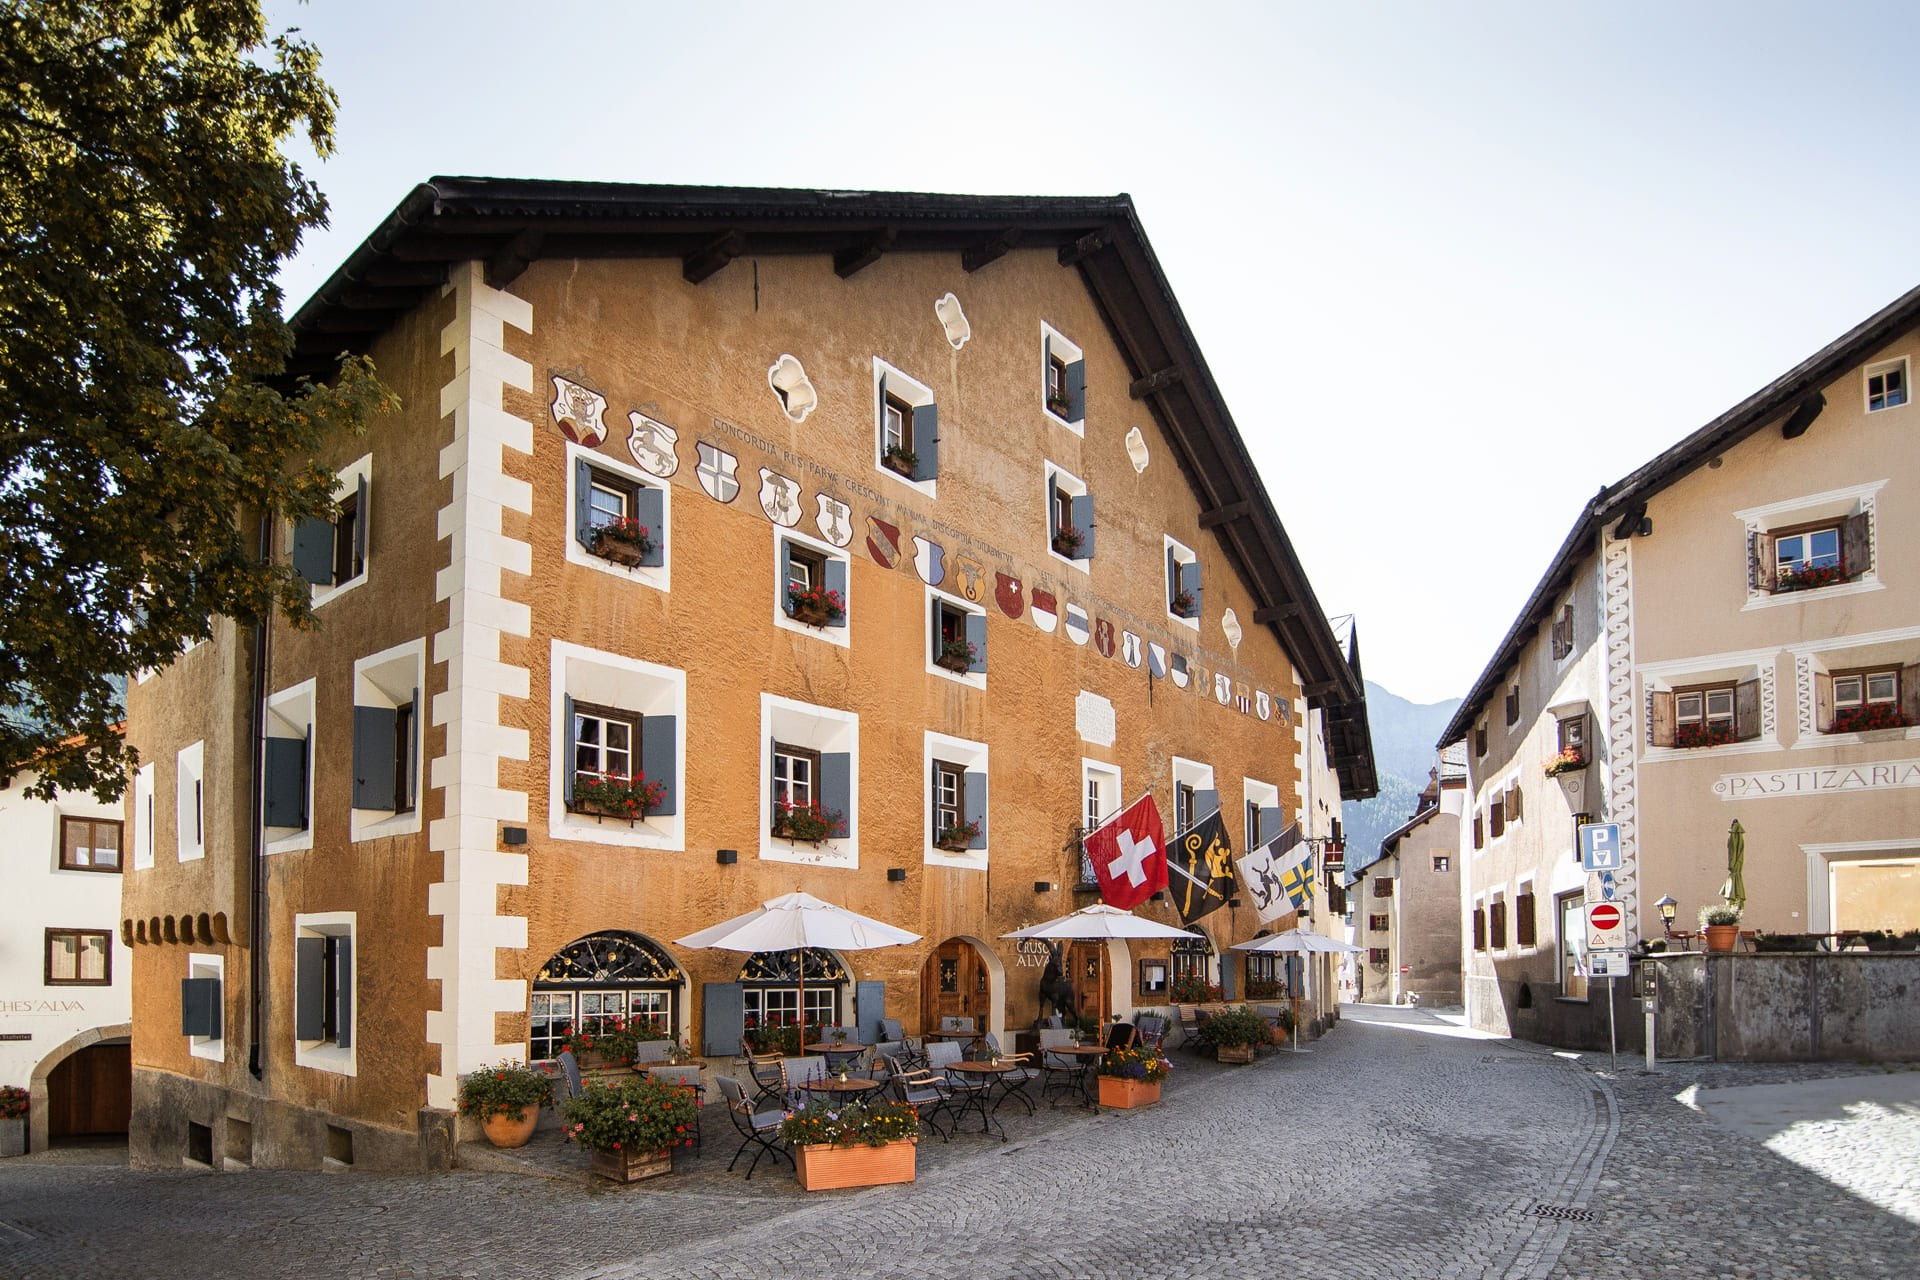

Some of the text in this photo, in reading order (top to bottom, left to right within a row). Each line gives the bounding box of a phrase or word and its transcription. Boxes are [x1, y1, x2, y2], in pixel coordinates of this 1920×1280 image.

[714, 418, 776, 455] CONCORDIA
[784, 451, 803, 468] RES
[1730, 763, 1920, 795] PASTIZARIA
[1592, 828, 1608, 850] P
